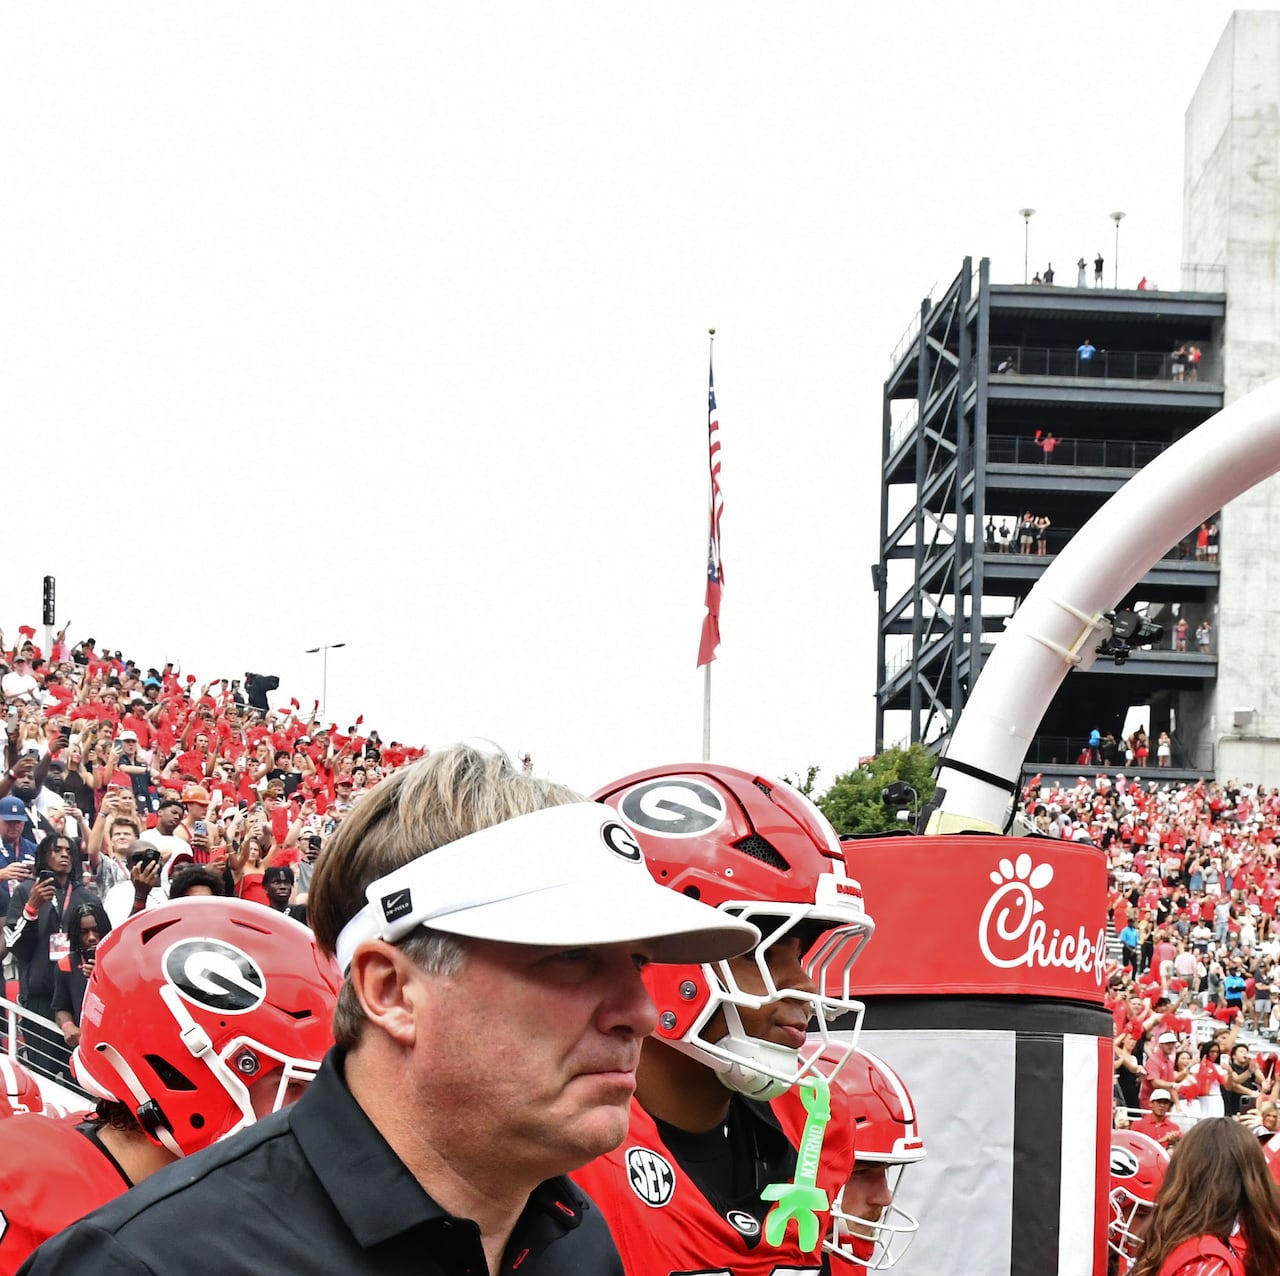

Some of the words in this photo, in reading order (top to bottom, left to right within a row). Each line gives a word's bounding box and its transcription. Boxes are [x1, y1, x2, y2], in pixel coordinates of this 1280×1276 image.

[600, 820, 642, 863] G
[801, 1124, 823, 1179] NXTRND
[626, 1148, 673, 1206] SEC
[726, 1210, 760, 1236] G
